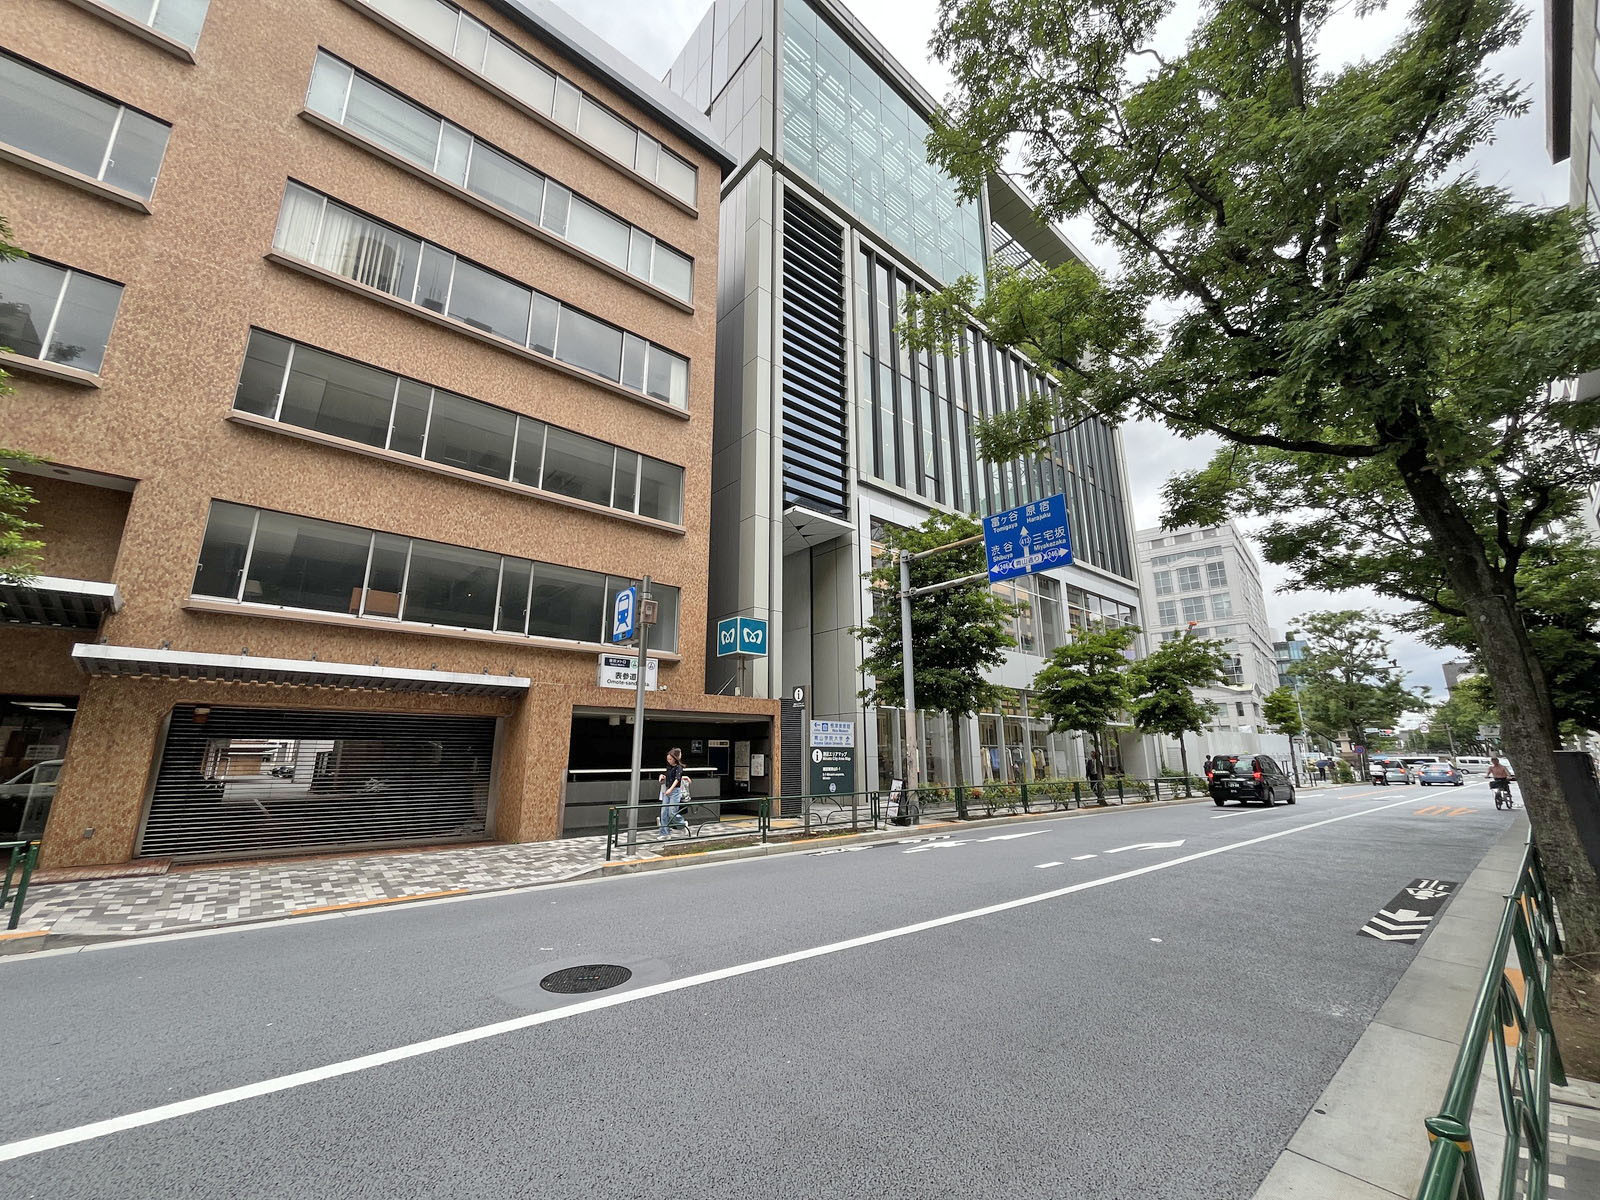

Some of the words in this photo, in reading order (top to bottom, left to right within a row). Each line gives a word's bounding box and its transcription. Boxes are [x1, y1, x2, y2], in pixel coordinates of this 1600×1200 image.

[1026, 501, 1049, 516] 原宿
[1026, 512, 1051, 523] Harajuku
[993, 522, 1018, 533] Tomigaya
[1033, 526, 1065, 544] 三宅坂
[991, 541, 1012, 556] 渋谷
[1034, 538, 1066, 550] Miyakezaka
[993, 553, 1013, 562] Shibuya
